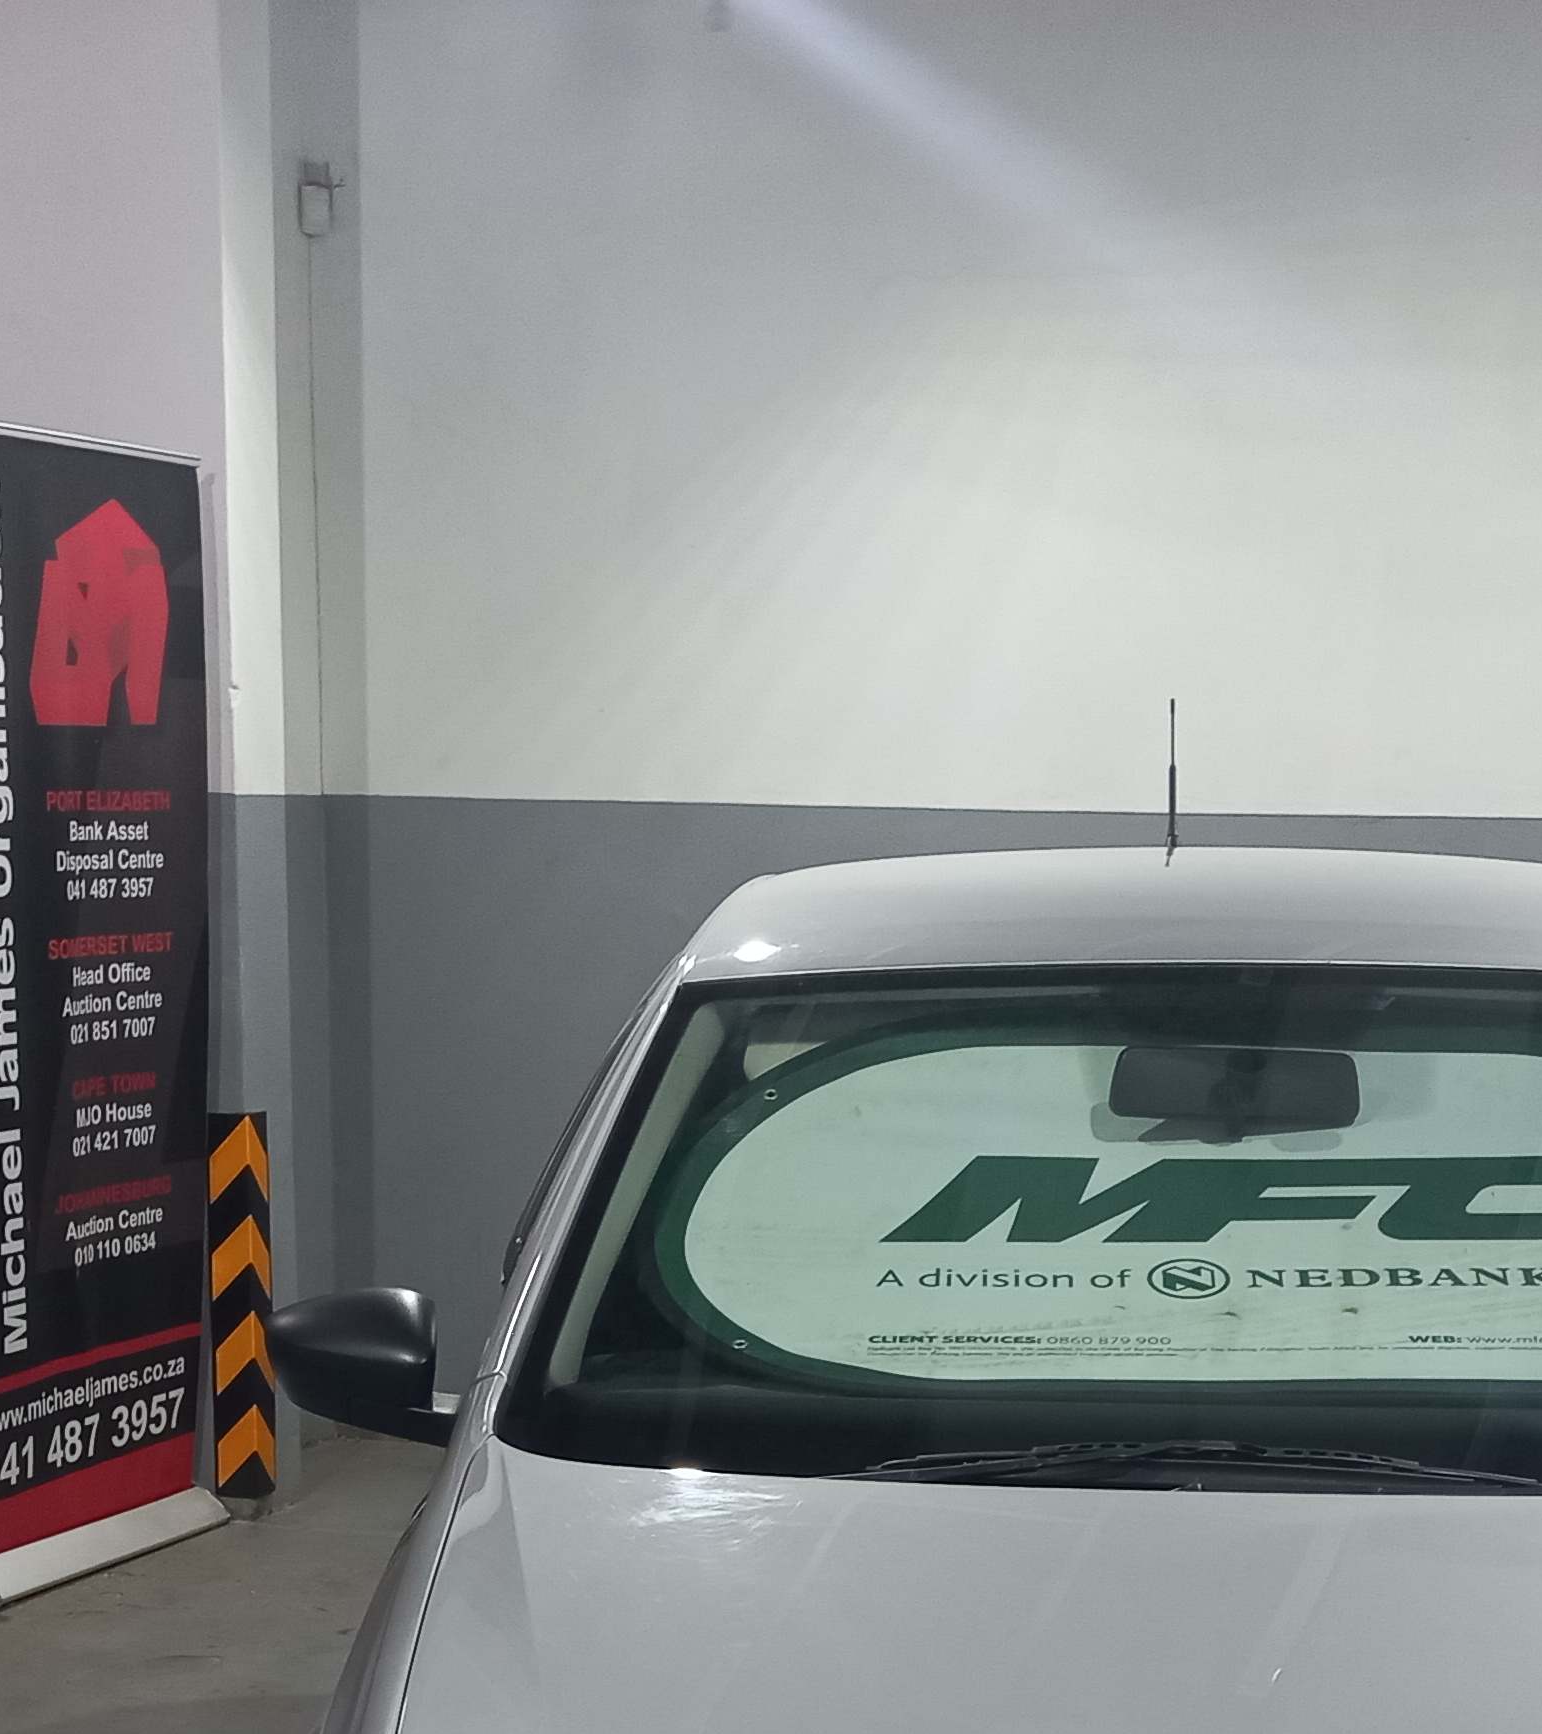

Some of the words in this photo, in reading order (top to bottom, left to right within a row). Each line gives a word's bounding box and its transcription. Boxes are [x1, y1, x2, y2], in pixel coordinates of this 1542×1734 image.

[70, 821, 103, 841] Bank
[107, 821, 148, 840] Asset
[57, 849, 113, 875] Disposal
[118, 849, 163, 869] Centre
[77, 1105, 101, 1128] MJO
[106, 1103, 151, 1122] House
[877, 1270, 903, 1287] A
[919, 1268, 1073, 1287] division
[1090, 1269, 1131, 1288] of
[868, 1335, 939, 1344] CLIENT
[941, 1335, 1042, 1345] SERVICES:
[1046, 1336, 1094, 1345] 0860
[1098, 1336, 1132, 1345] 879
[1135, 1336, 1172, 1346] 900
[48, 1413, 99, 1467] 487
[112, 1388, 184, 1447] 3957
